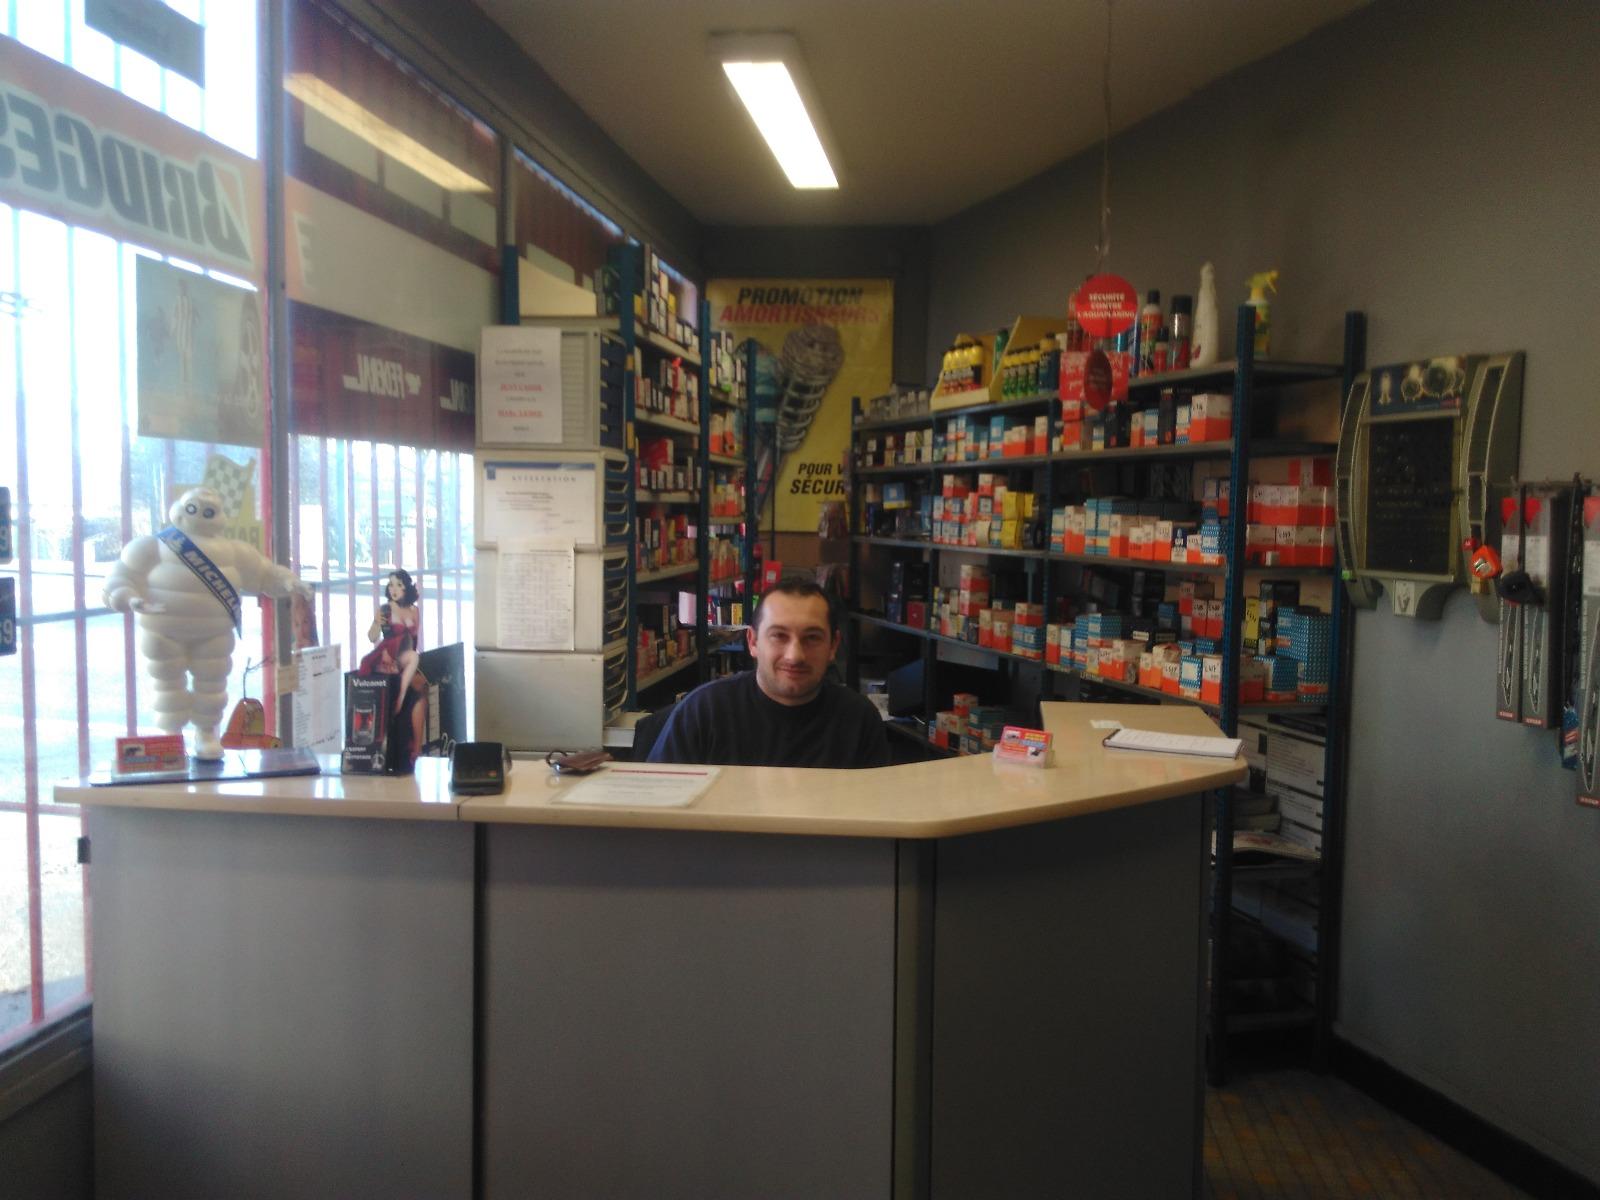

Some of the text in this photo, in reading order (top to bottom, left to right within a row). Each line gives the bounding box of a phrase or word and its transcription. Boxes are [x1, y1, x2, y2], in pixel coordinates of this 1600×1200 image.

[738, 287, 864, 305] PROMOTION
[798, 462, 832, 475] POUR
[790, 477, 845, 494] SÉCUR
